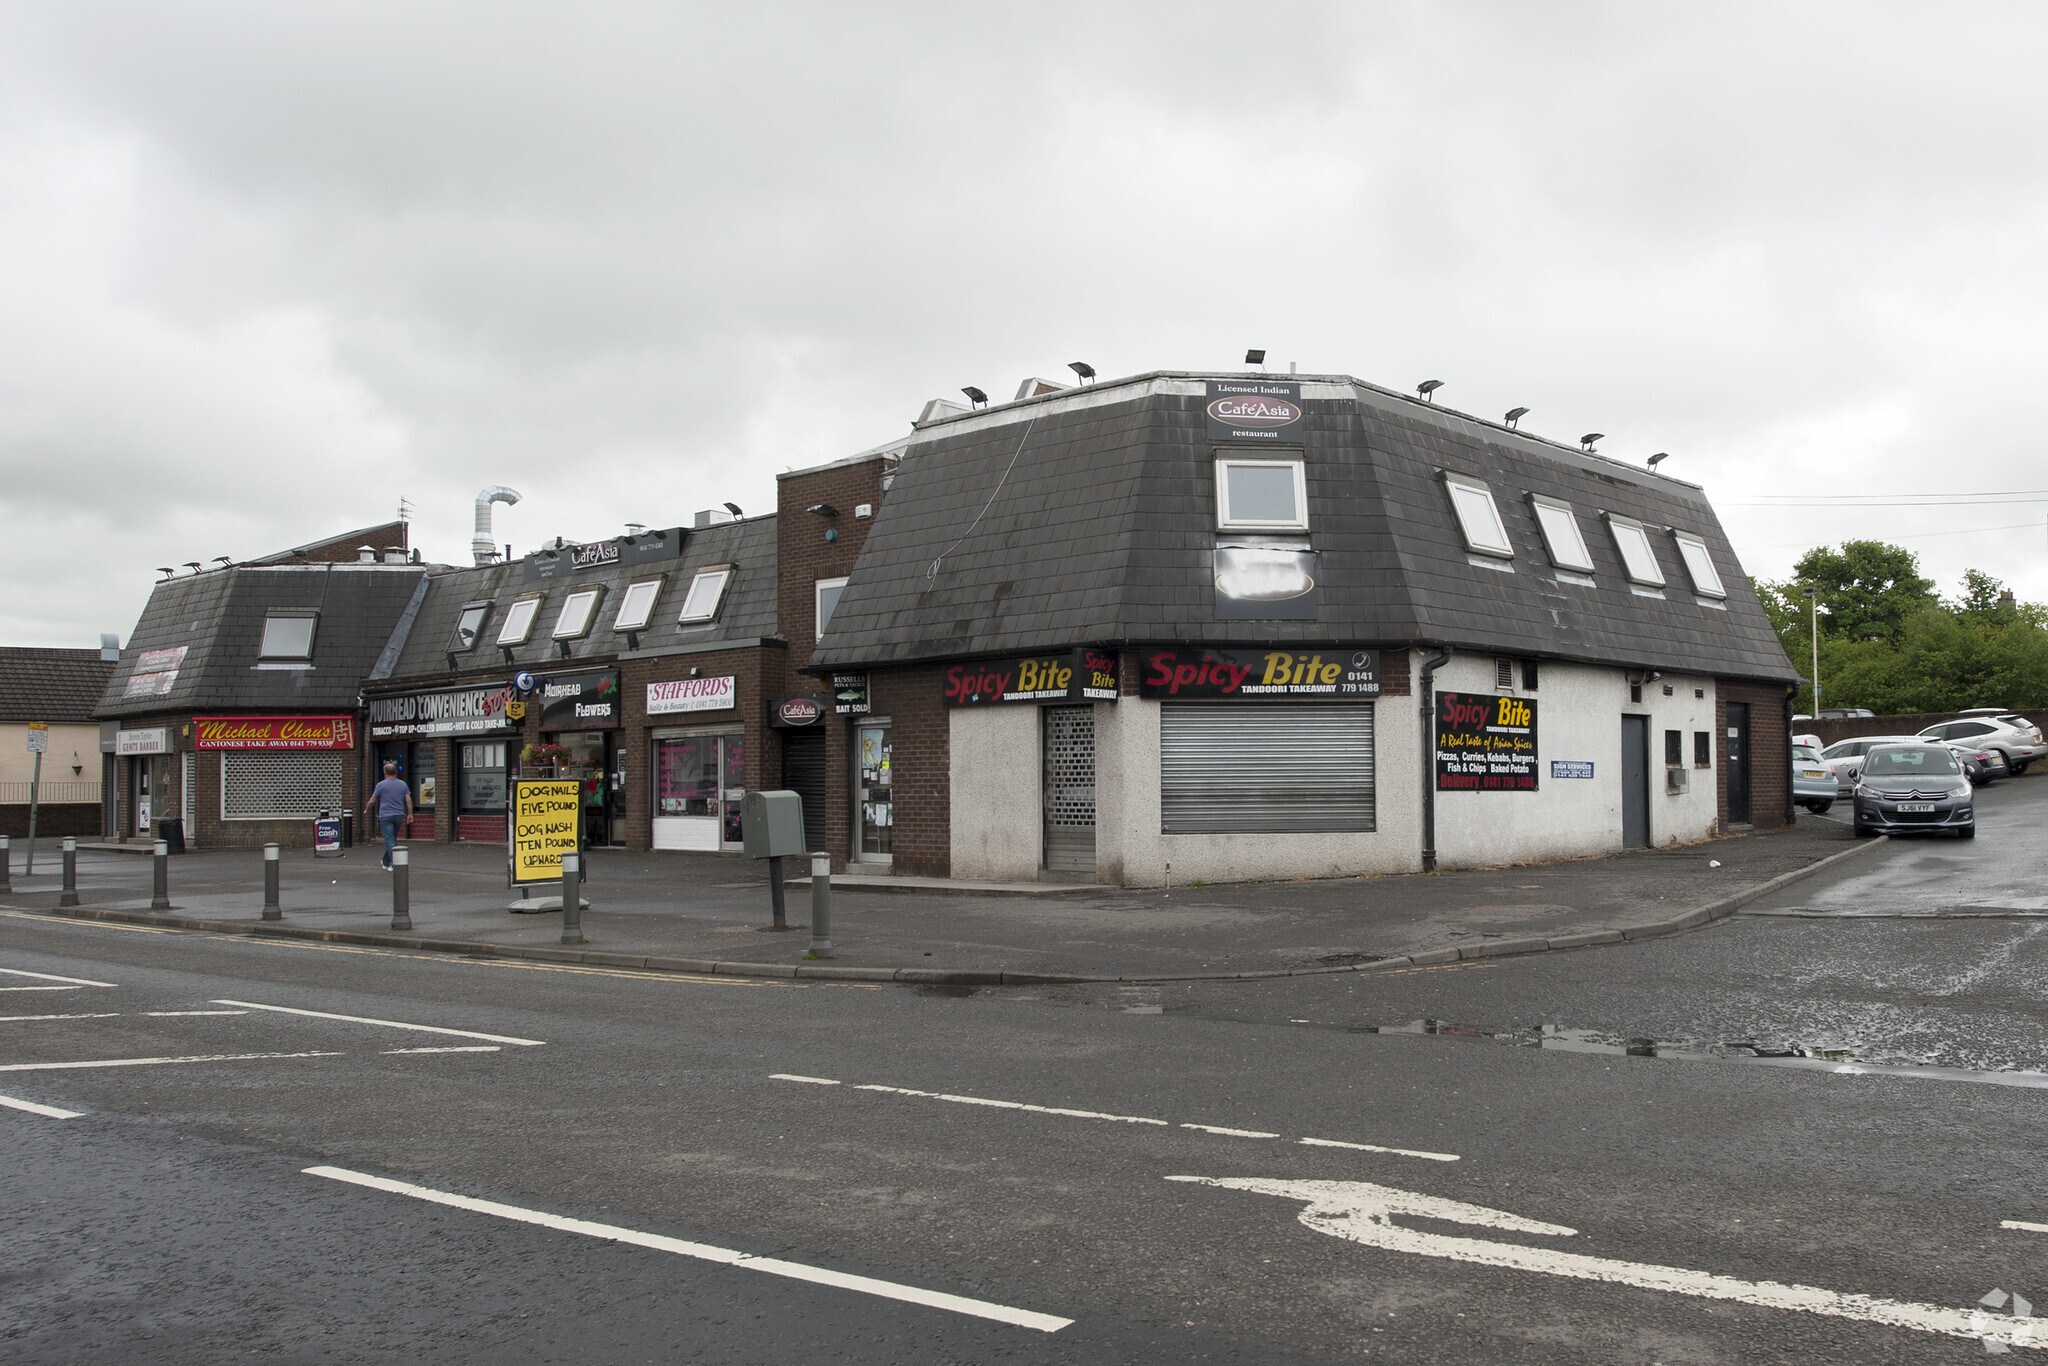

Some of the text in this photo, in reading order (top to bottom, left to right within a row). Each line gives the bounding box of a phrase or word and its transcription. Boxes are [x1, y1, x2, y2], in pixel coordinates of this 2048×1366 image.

[1217, 384, 1290, 394] Licensed Indian
[1232, 430, 1278, 438] restaurant
[1084, 651, 1115, 673] Spicy
[833, 675, 866, 683] RUSSELLS
[1092, 672, 1115, 688] Bite
[1146, 652, 1342, 695] Spicy Bite
[1347, 671, 1373, 681] 0141
[945, 658, 1072, 704] Spicy Bite
[1341, 682, 1380, 692] 779 1488
[544, 683, 582, 697] MUIRHEAD
[651, 677, 730, 702] STAFFORDS
[1003, 689, 1068, 701] TANDOORI TAKEAWAY
[1083, 688, 1118, 699] TAKEAWAY
[1240, 684, 1336, 694] TANDOORI TAKEAWAY
[369, 697, 416, 723] MUIRHEAD
[417, 691, 485, 720] CONVENIENCE
[575, 702, 611, 717] FLOWERS
[670, 702, 688, 711] Beauty
[836, 704, 868, 713] BAIT SOLD
[1443, 693, 1531, 731] Spicy Bite
[199, 719, 332, 739] Michael Chau's
[373, 726, 392, 736] TOBACCO
[399, 725, 408, 734] TOP
[408, 725, 415, 733] UP
[416, 723, 435, 733] CHILLED
[436, 722, 453, 732] DRINKS
[455, 721, 465, 731] HOT
[470, 720, 483, 730] COLD
[123, 742, 138, 752] GENTS
[140, 741, 159, 752] BARBER
[1440, 733, 1533, 752] A Real Taste of Asian Spices
[1437, 751, 1460, 762] Pizzas,
[1462, 752, 1487, 763] Curries,
[1487, 753, 1512, 764] Kebabs,
[1447, 763, 1530, 774] Fish & Chips Baked Potato
[1440, 773, 1480, 789] Delivery
[1483, 776, 1501, 788] 0141
[1503, 776, 1516, 788] 779
[520, 785, 580, 799] DOG NAILS
[522, 801, 577, 815] FIVE POUND
[318, 829, 338, 837] cash
[517, 822, 572, 837] DOG WASH
[517, 838, 575, 851] TEN POUND
